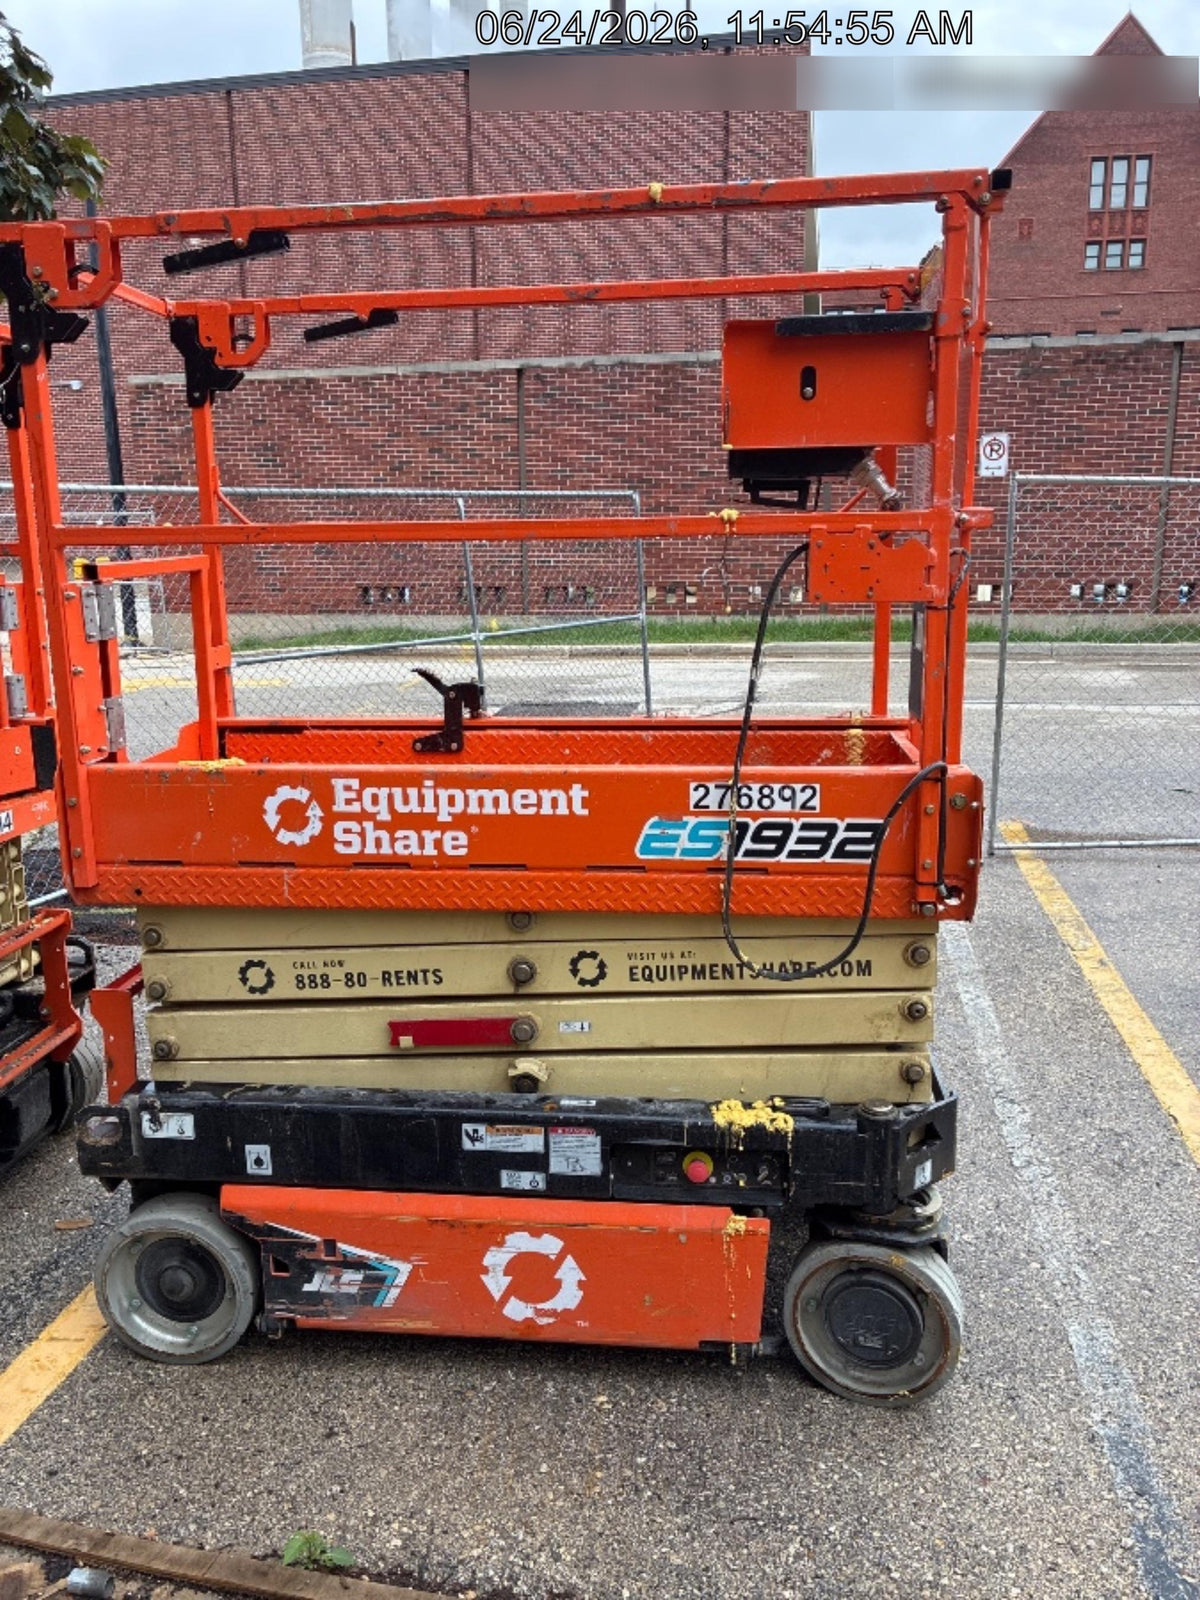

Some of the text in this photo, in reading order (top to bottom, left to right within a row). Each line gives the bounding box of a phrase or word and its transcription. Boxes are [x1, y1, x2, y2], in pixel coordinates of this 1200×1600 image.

[331, 778, 589, 822] Equipment
[692, 783, 818, 811] 276892
[333, 820, 469, 856] Share
[635, 815, 886, 863] ES1932
[292, 960, 318, 970] CALL
[627, 952, 656, 961] VISIT
[294, 968, 444, 991] 888-80-RENTS
